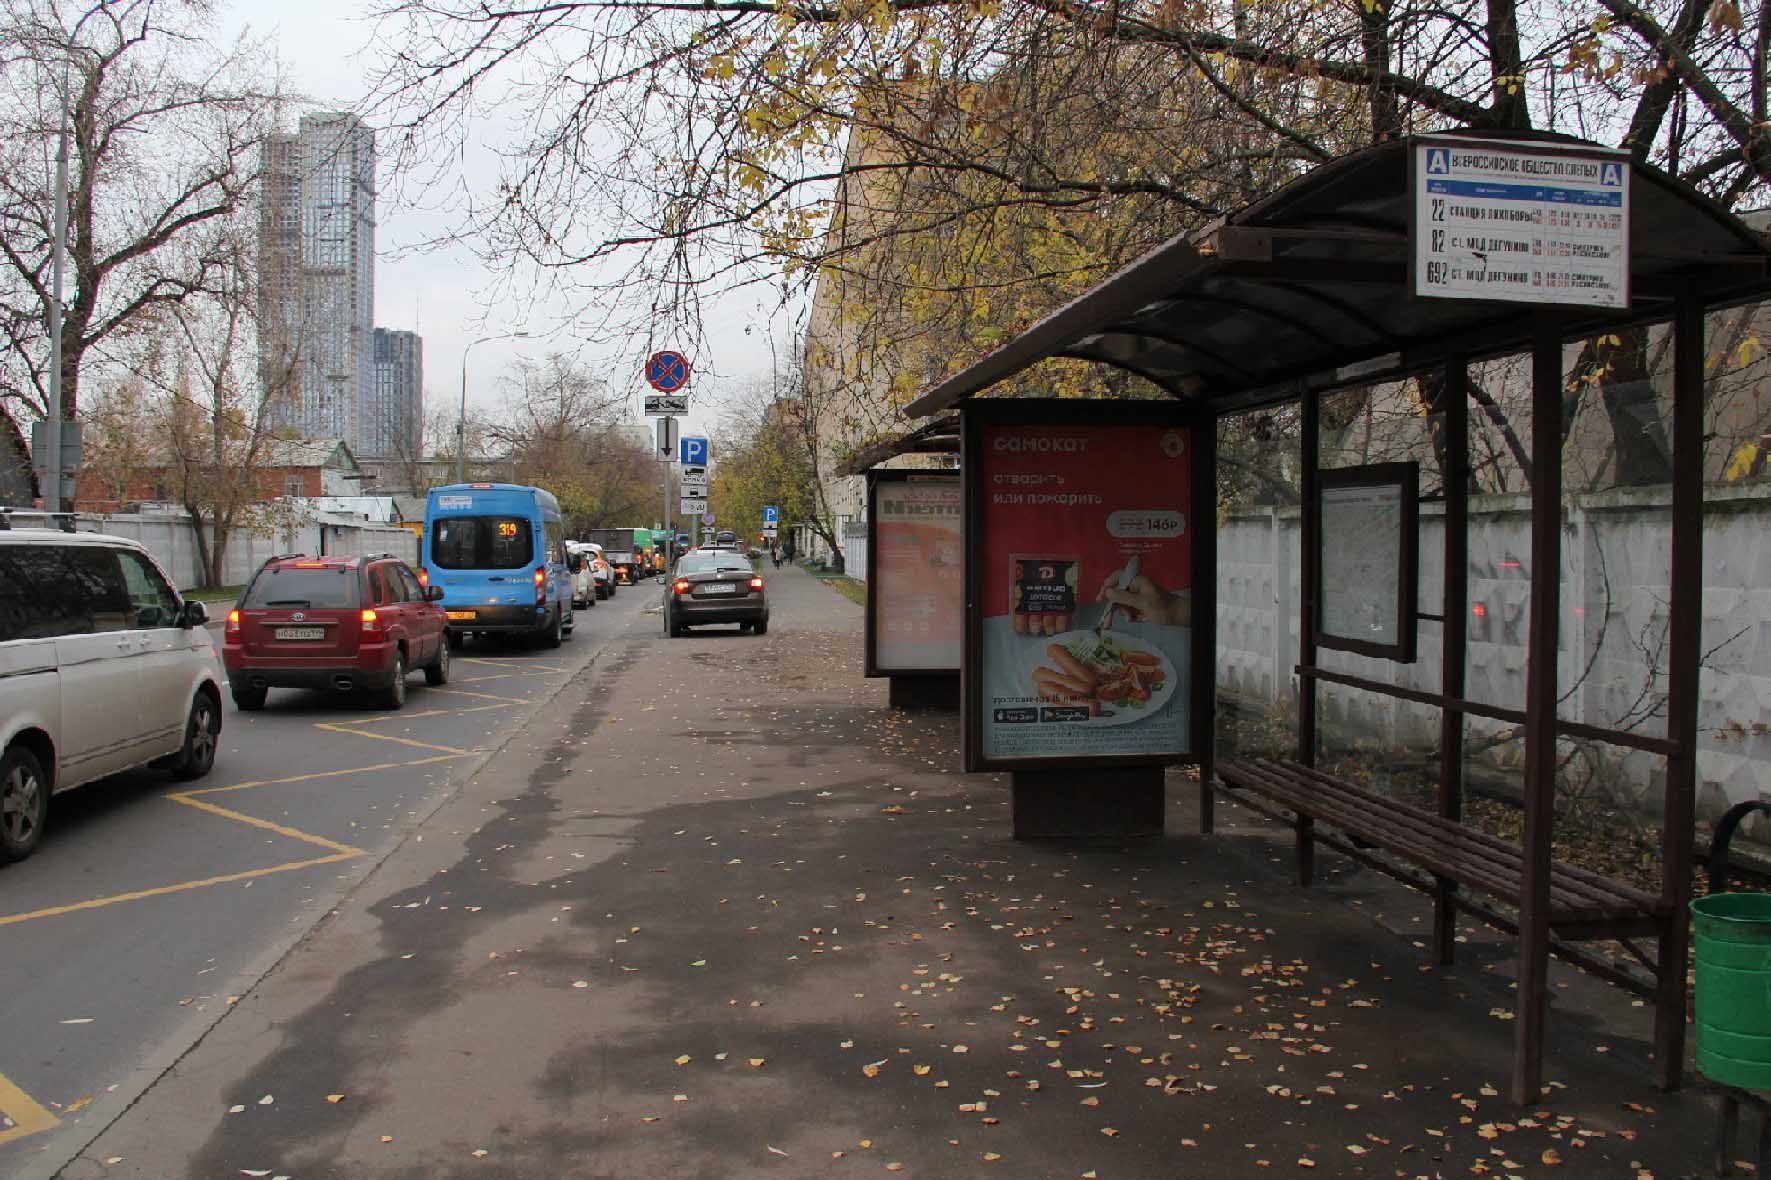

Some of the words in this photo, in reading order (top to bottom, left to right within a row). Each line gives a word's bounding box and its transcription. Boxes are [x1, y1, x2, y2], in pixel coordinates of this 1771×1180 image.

[1452, 155, 1519, 173] ВСЕРОССИЙСКОЕ
[1521, 159, 1563, 175] ОБЩЕСТВО
[1565, 162, 1598, 177] СЛЕПЫХ
[1432, 199, 1445, 222] 22
[1450, 206, 1486, 219] СТАНЦИЯ
[1432, 229, 1445, 253] 82
[1488, 239, 1529, 252] ДЕГУНИНО
[1427, 262, 1447, 285] 692
[1488, 271, 1528, 283] ДЕГУНИНО
[687, 440, 702, 462] P
[993, 473, 1065, 487] отварить
[993, 493, 1023, 505] или
[1027, 493, 1103, 506] пожарить
[498, 522, 518, 537] 319
